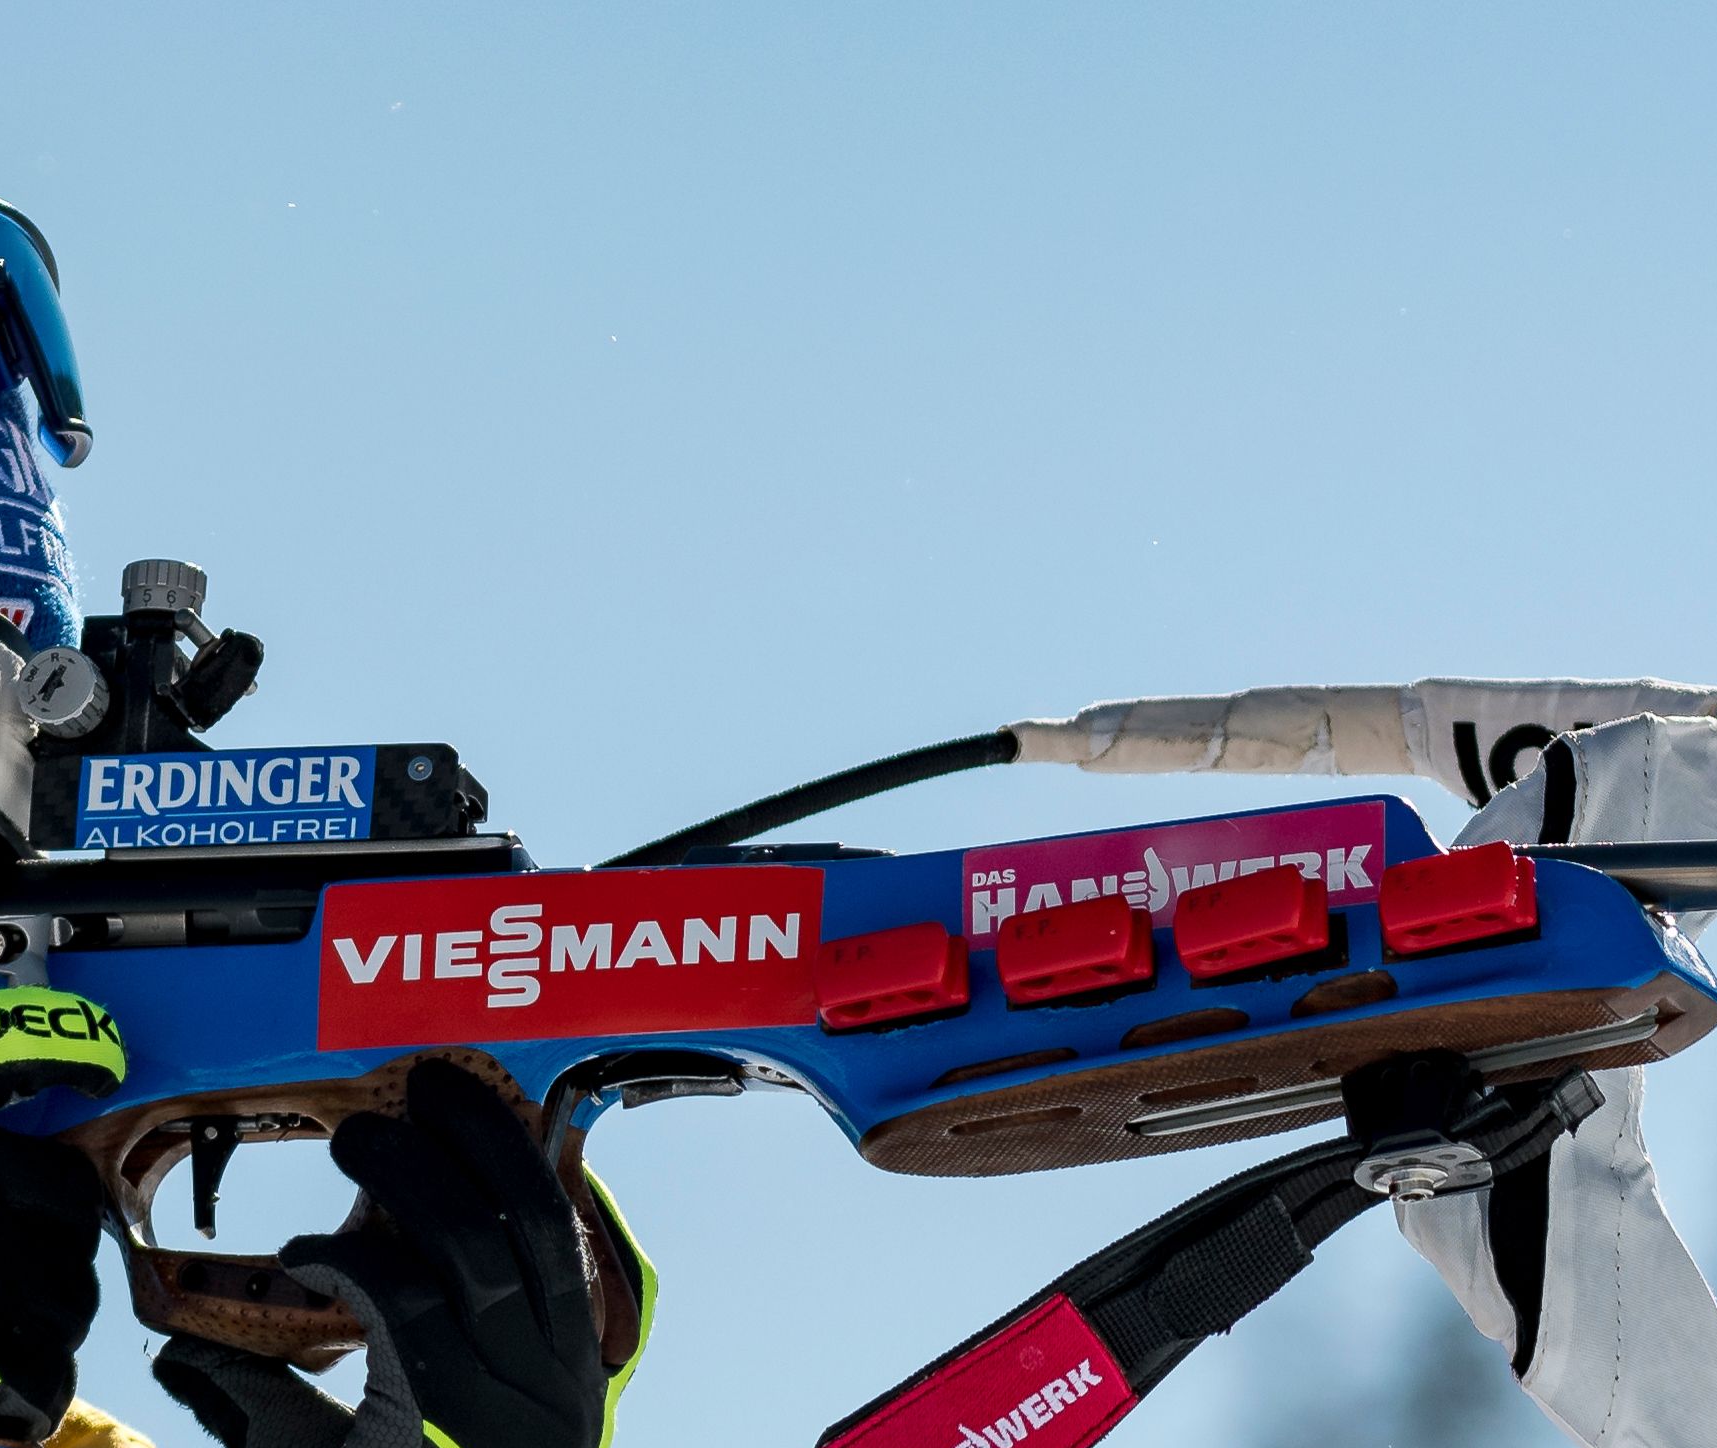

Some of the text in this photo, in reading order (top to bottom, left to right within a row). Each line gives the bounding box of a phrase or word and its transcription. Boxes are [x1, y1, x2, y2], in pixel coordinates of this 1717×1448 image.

[85, 755, 366, 817] ERDINGER
[82, 816, 358, 848] ALKOHOLFREI
[971, 868, 1017, 887] DAS
[332, 903, 801, 1009] VIESSMANN
